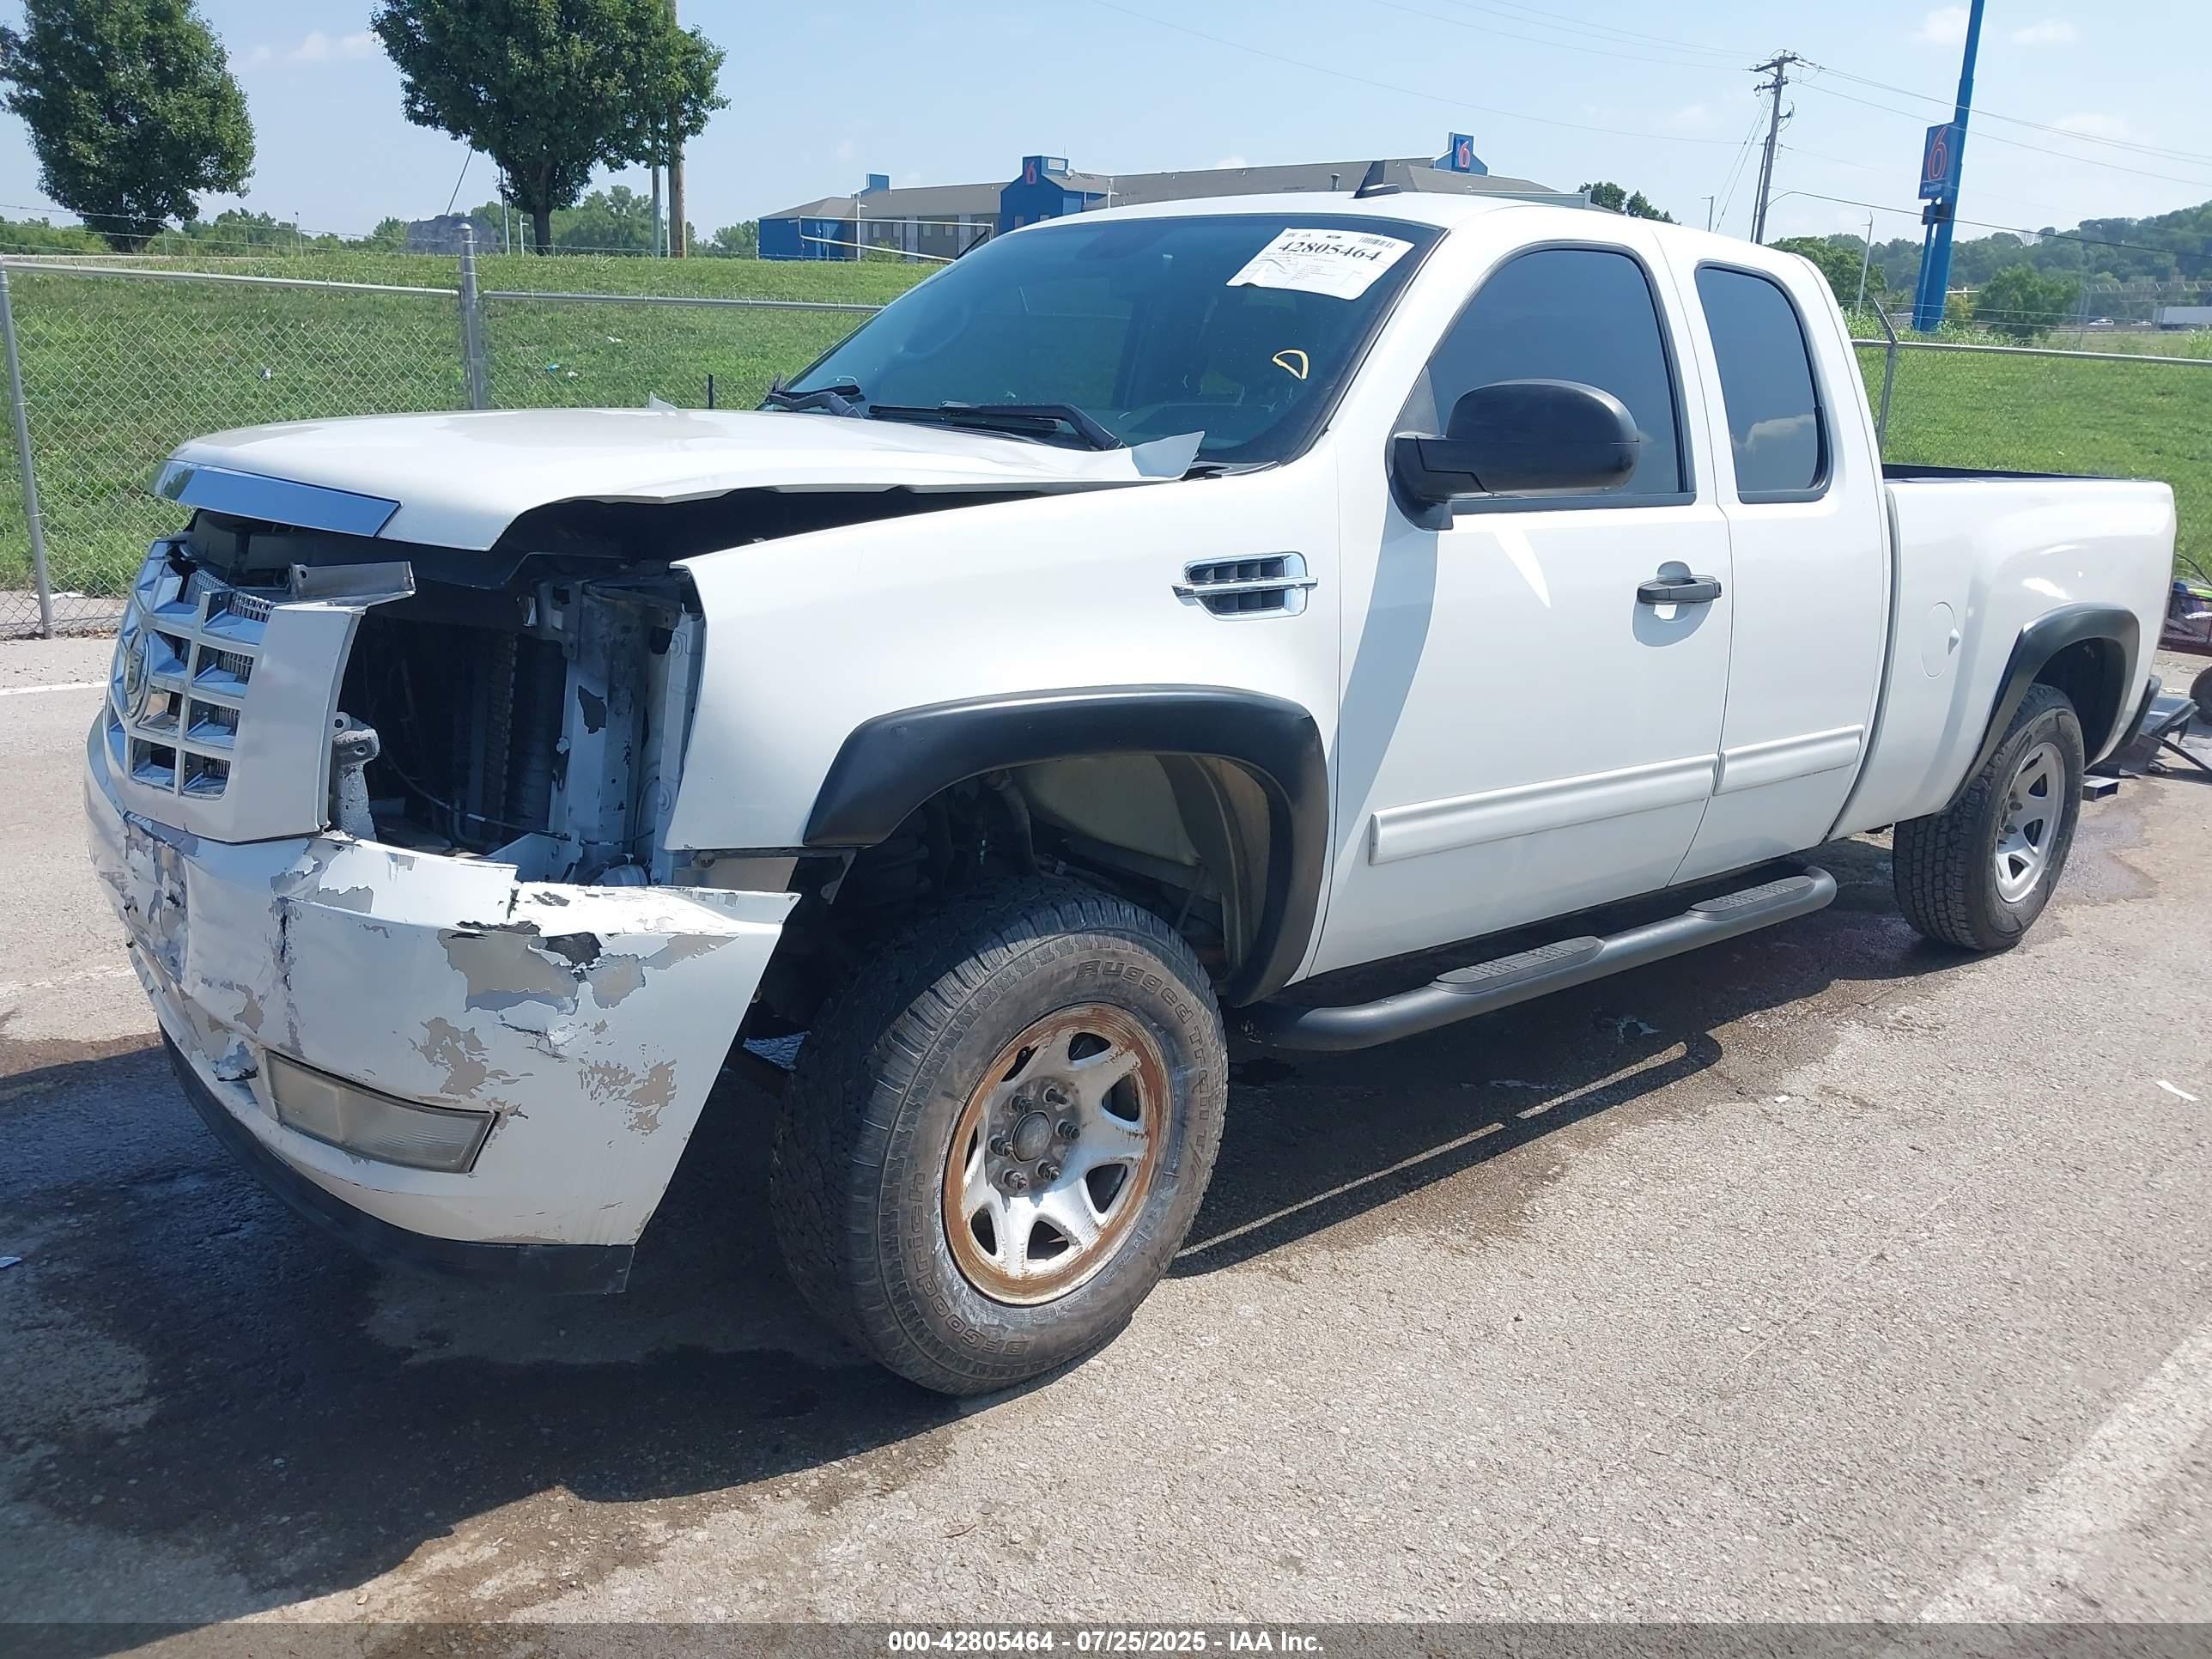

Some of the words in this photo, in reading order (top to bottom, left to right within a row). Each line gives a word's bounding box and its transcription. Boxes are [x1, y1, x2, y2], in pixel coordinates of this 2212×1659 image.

[1026, 161, 1036, 185] 6
[1459, 140, 1470, 168] 6
[1928, 126, 1947, 180] 6
[1278, 241, 1382, 261] 42805464
[1076, 958, 1194, 1025] Rugged
[1188, 1024, 1211, 1121] Trail
[1182, 1132, 1207, 1195] T/A
[908, 1172, 1031, 1356] BFGoodrich
